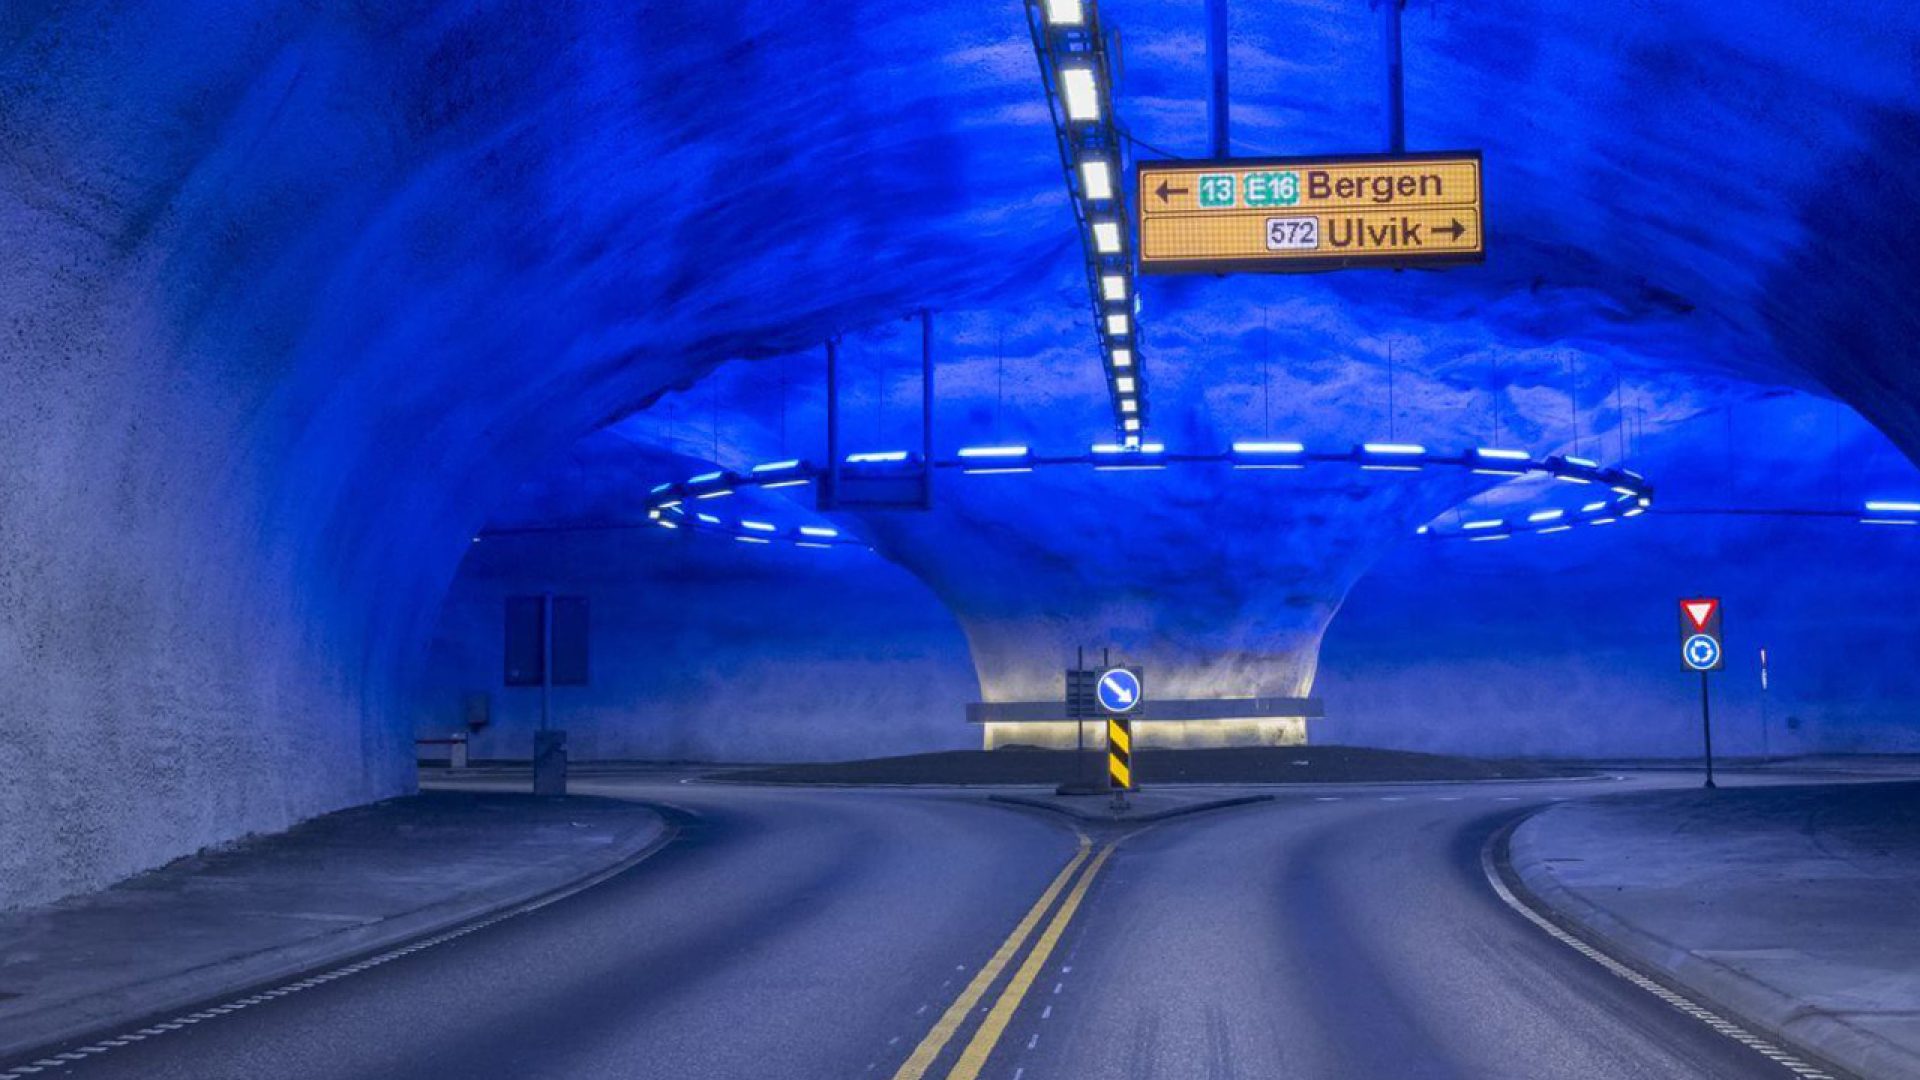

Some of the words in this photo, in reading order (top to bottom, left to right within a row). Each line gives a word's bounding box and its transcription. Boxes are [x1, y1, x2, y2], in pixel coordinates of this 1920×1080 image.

[1201, 179, 1231, 202] 13
[1249, 178, 1295, 202] E16
[1308, 170, 1443, 203] Bergen
[1270, 221, 1316, 245] 572
[1328, 217, 1423, 248] Ulvik
